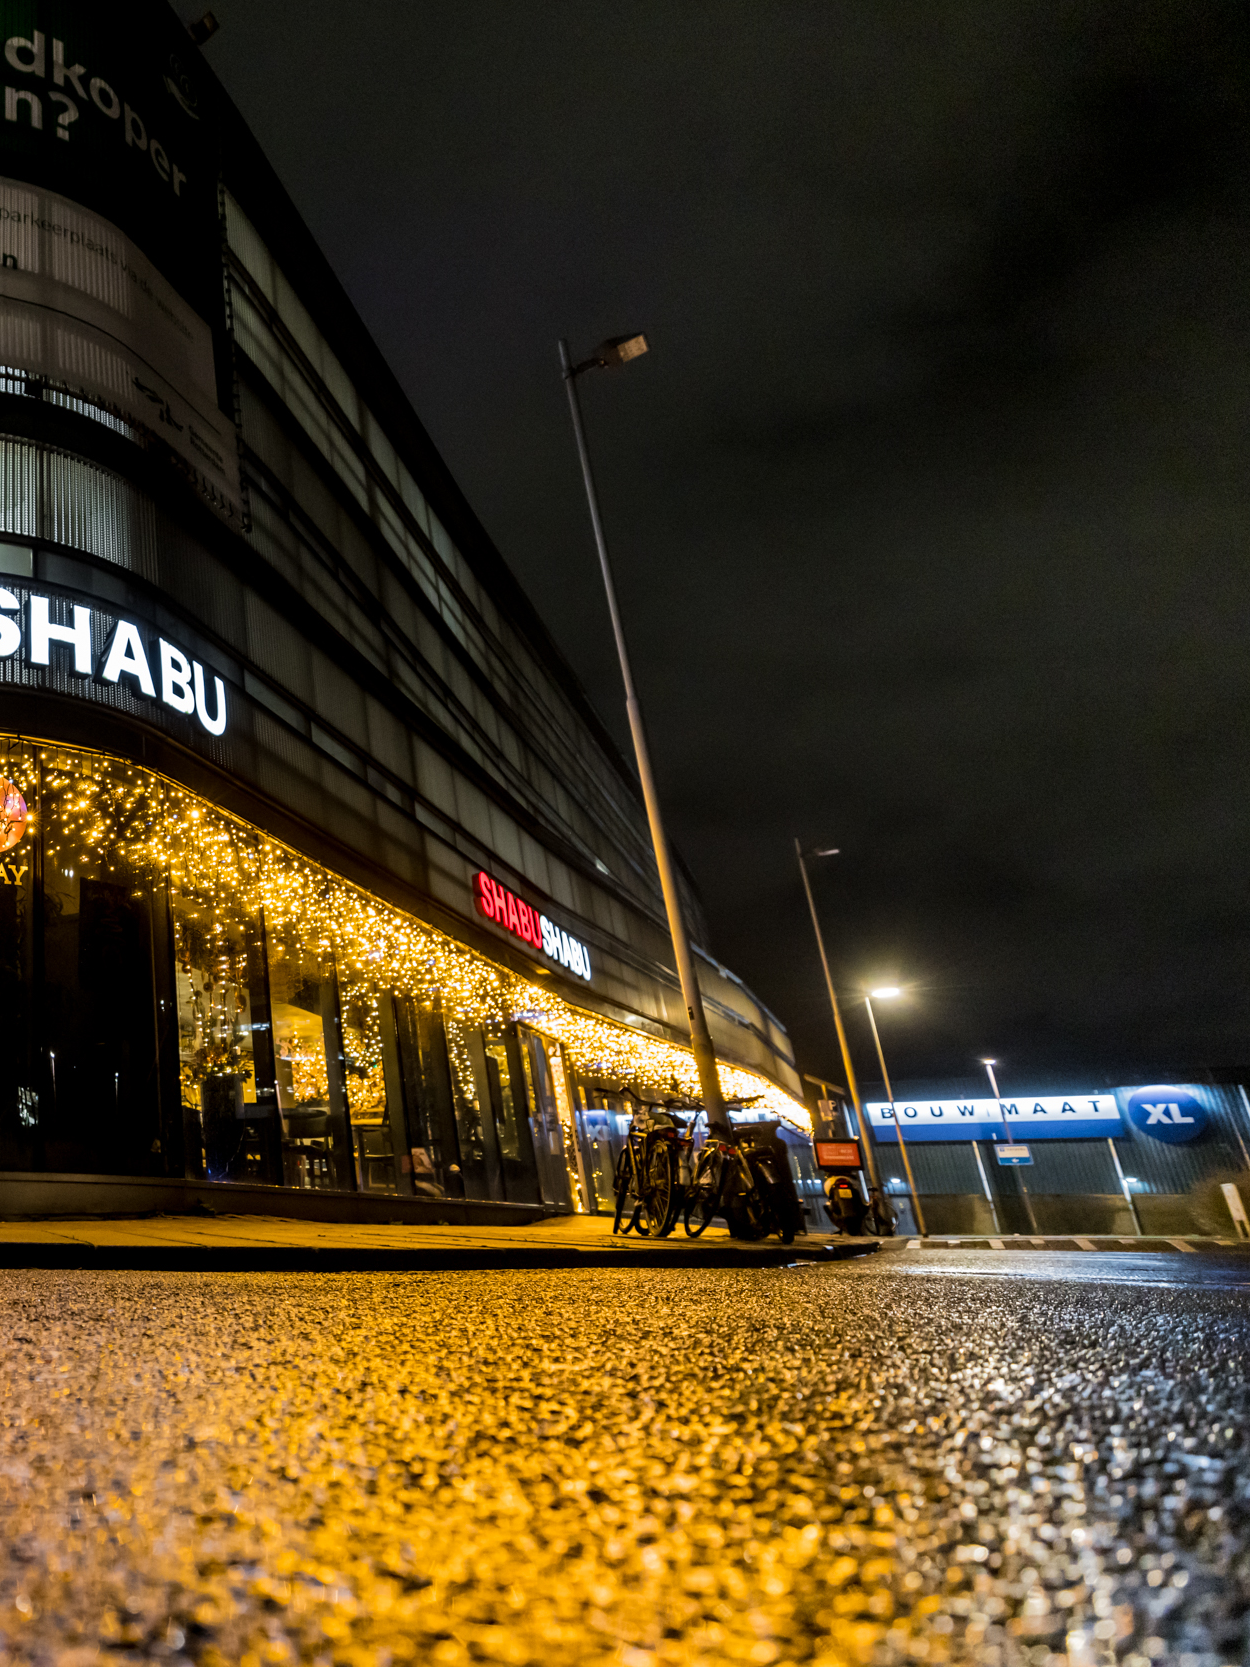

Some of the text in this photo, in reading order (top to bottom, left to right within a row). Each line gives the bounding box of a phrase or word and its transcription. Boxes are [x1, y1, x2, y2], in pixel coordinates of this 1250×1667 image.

[120, 257, 138, 285] via
[474, 870, 592, 982] SHABUSHABU
[1141, 1102, 1195, 1125] XL
